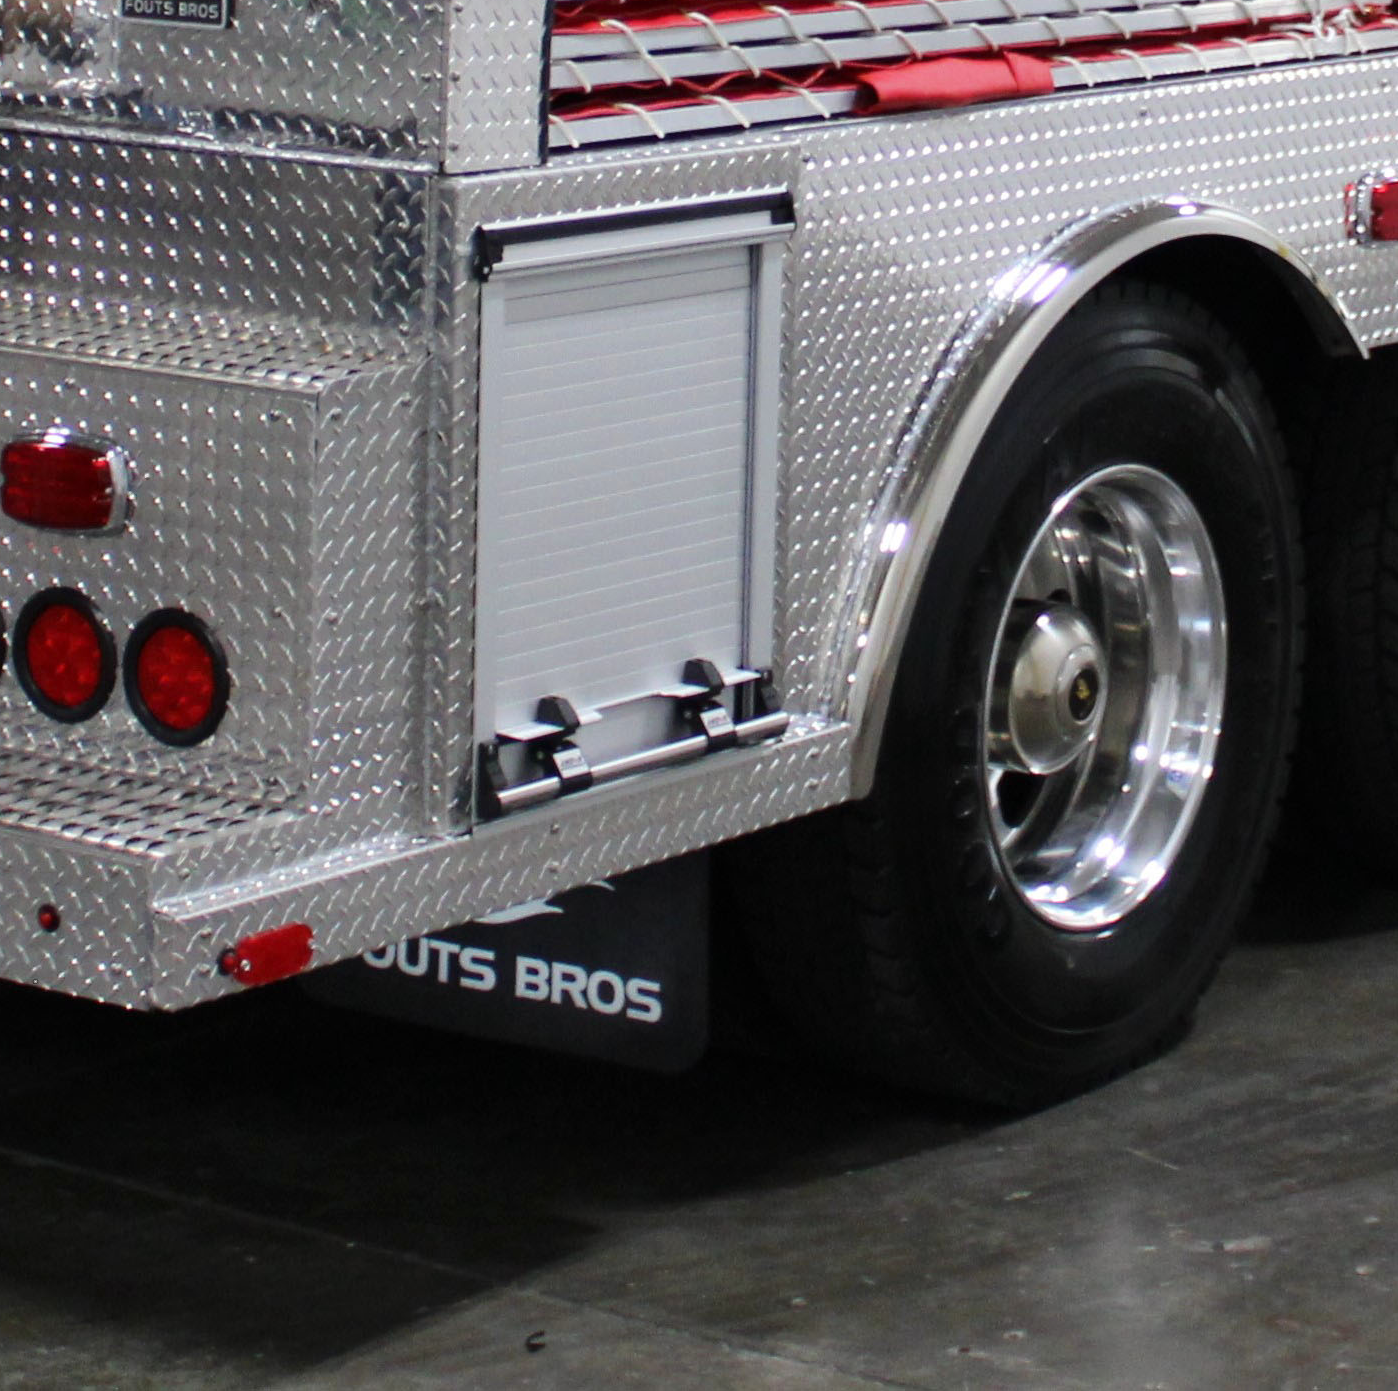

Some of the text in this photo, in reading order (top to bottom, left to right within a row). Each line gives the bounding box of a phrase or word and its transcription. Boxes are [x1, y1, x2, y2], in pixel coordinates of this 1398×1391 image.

[178, 1, 220, 20] BROS
[362, 937, 663, 1024] UTS BROS
